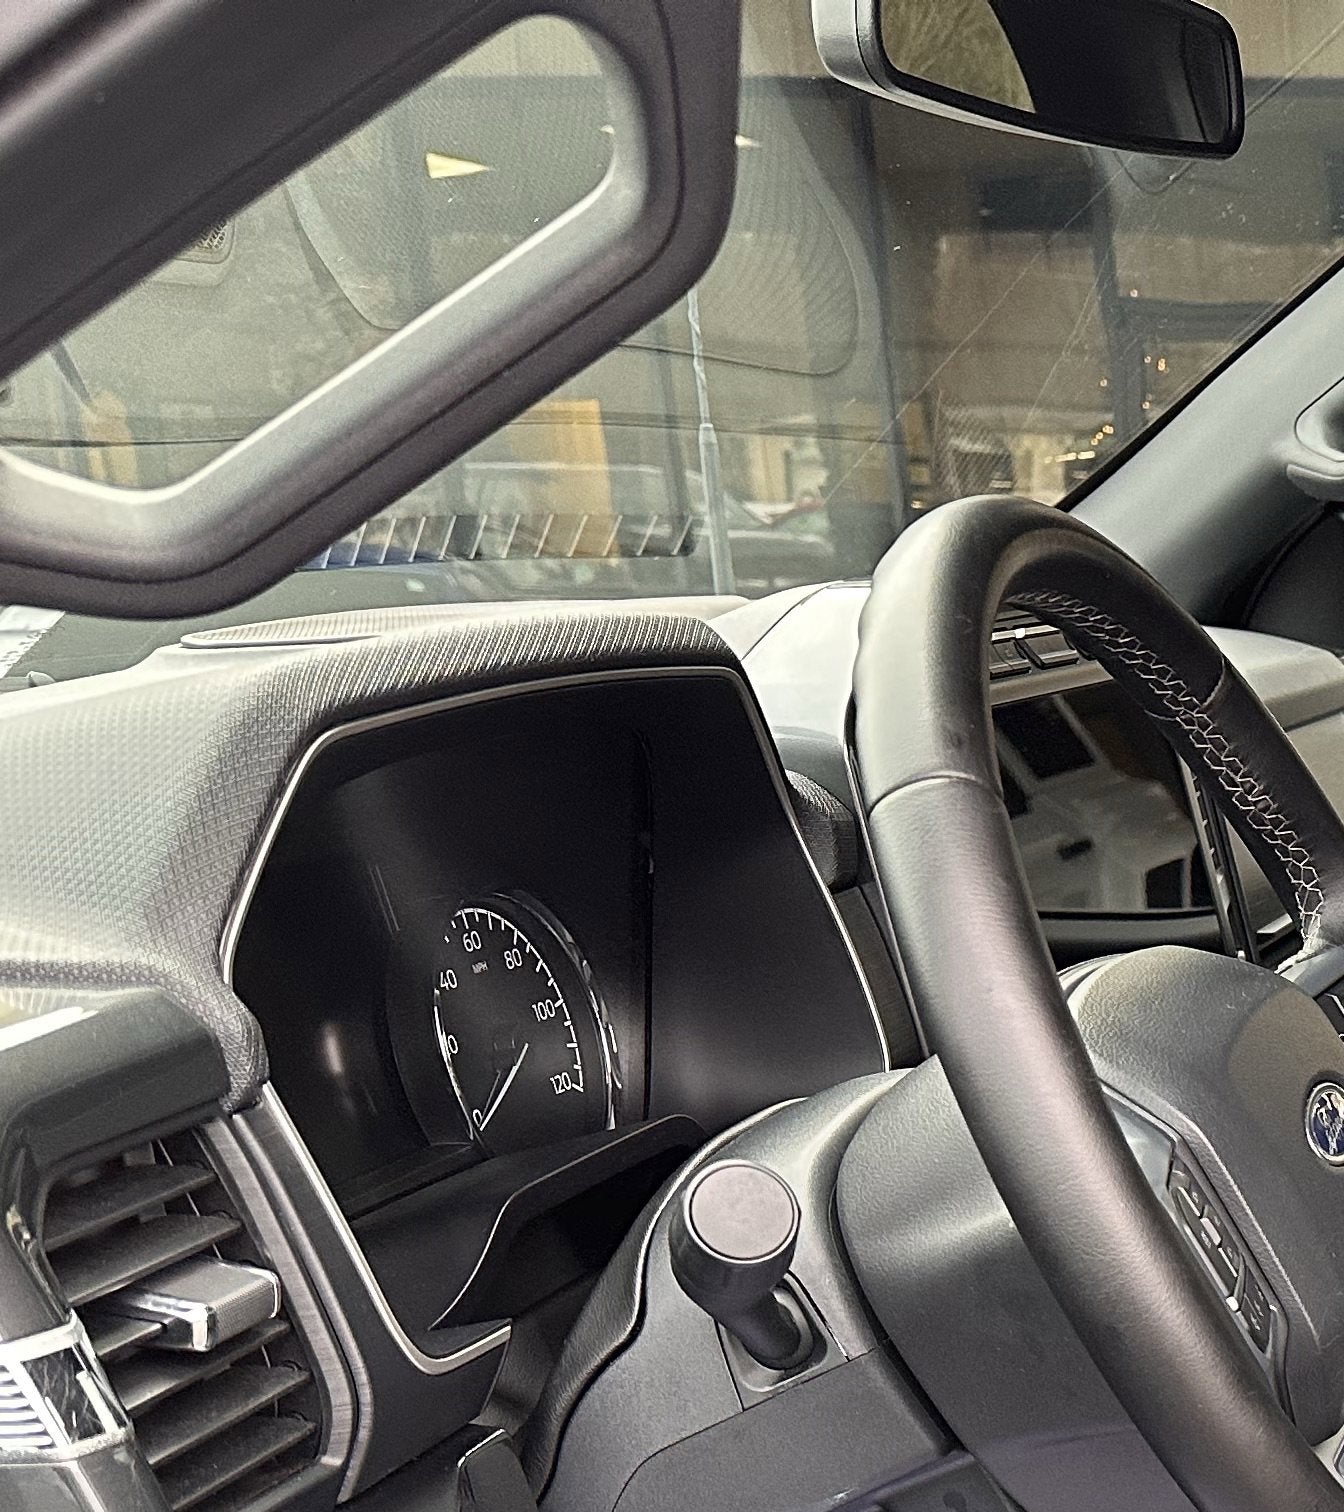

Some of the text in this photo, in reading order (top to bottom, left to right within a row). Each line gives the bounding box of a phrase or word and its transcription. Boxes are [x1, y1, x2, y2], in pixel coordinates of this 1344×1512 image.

[463, 931, 482, 952] 60
[504, 948, 522, 969] 80
[440, 970, 458, 990] 40
[532, 999, 556, 1022] 100
[550, 1071, 572, 1095] 120
[472, 1109, 483, 1126] 0
